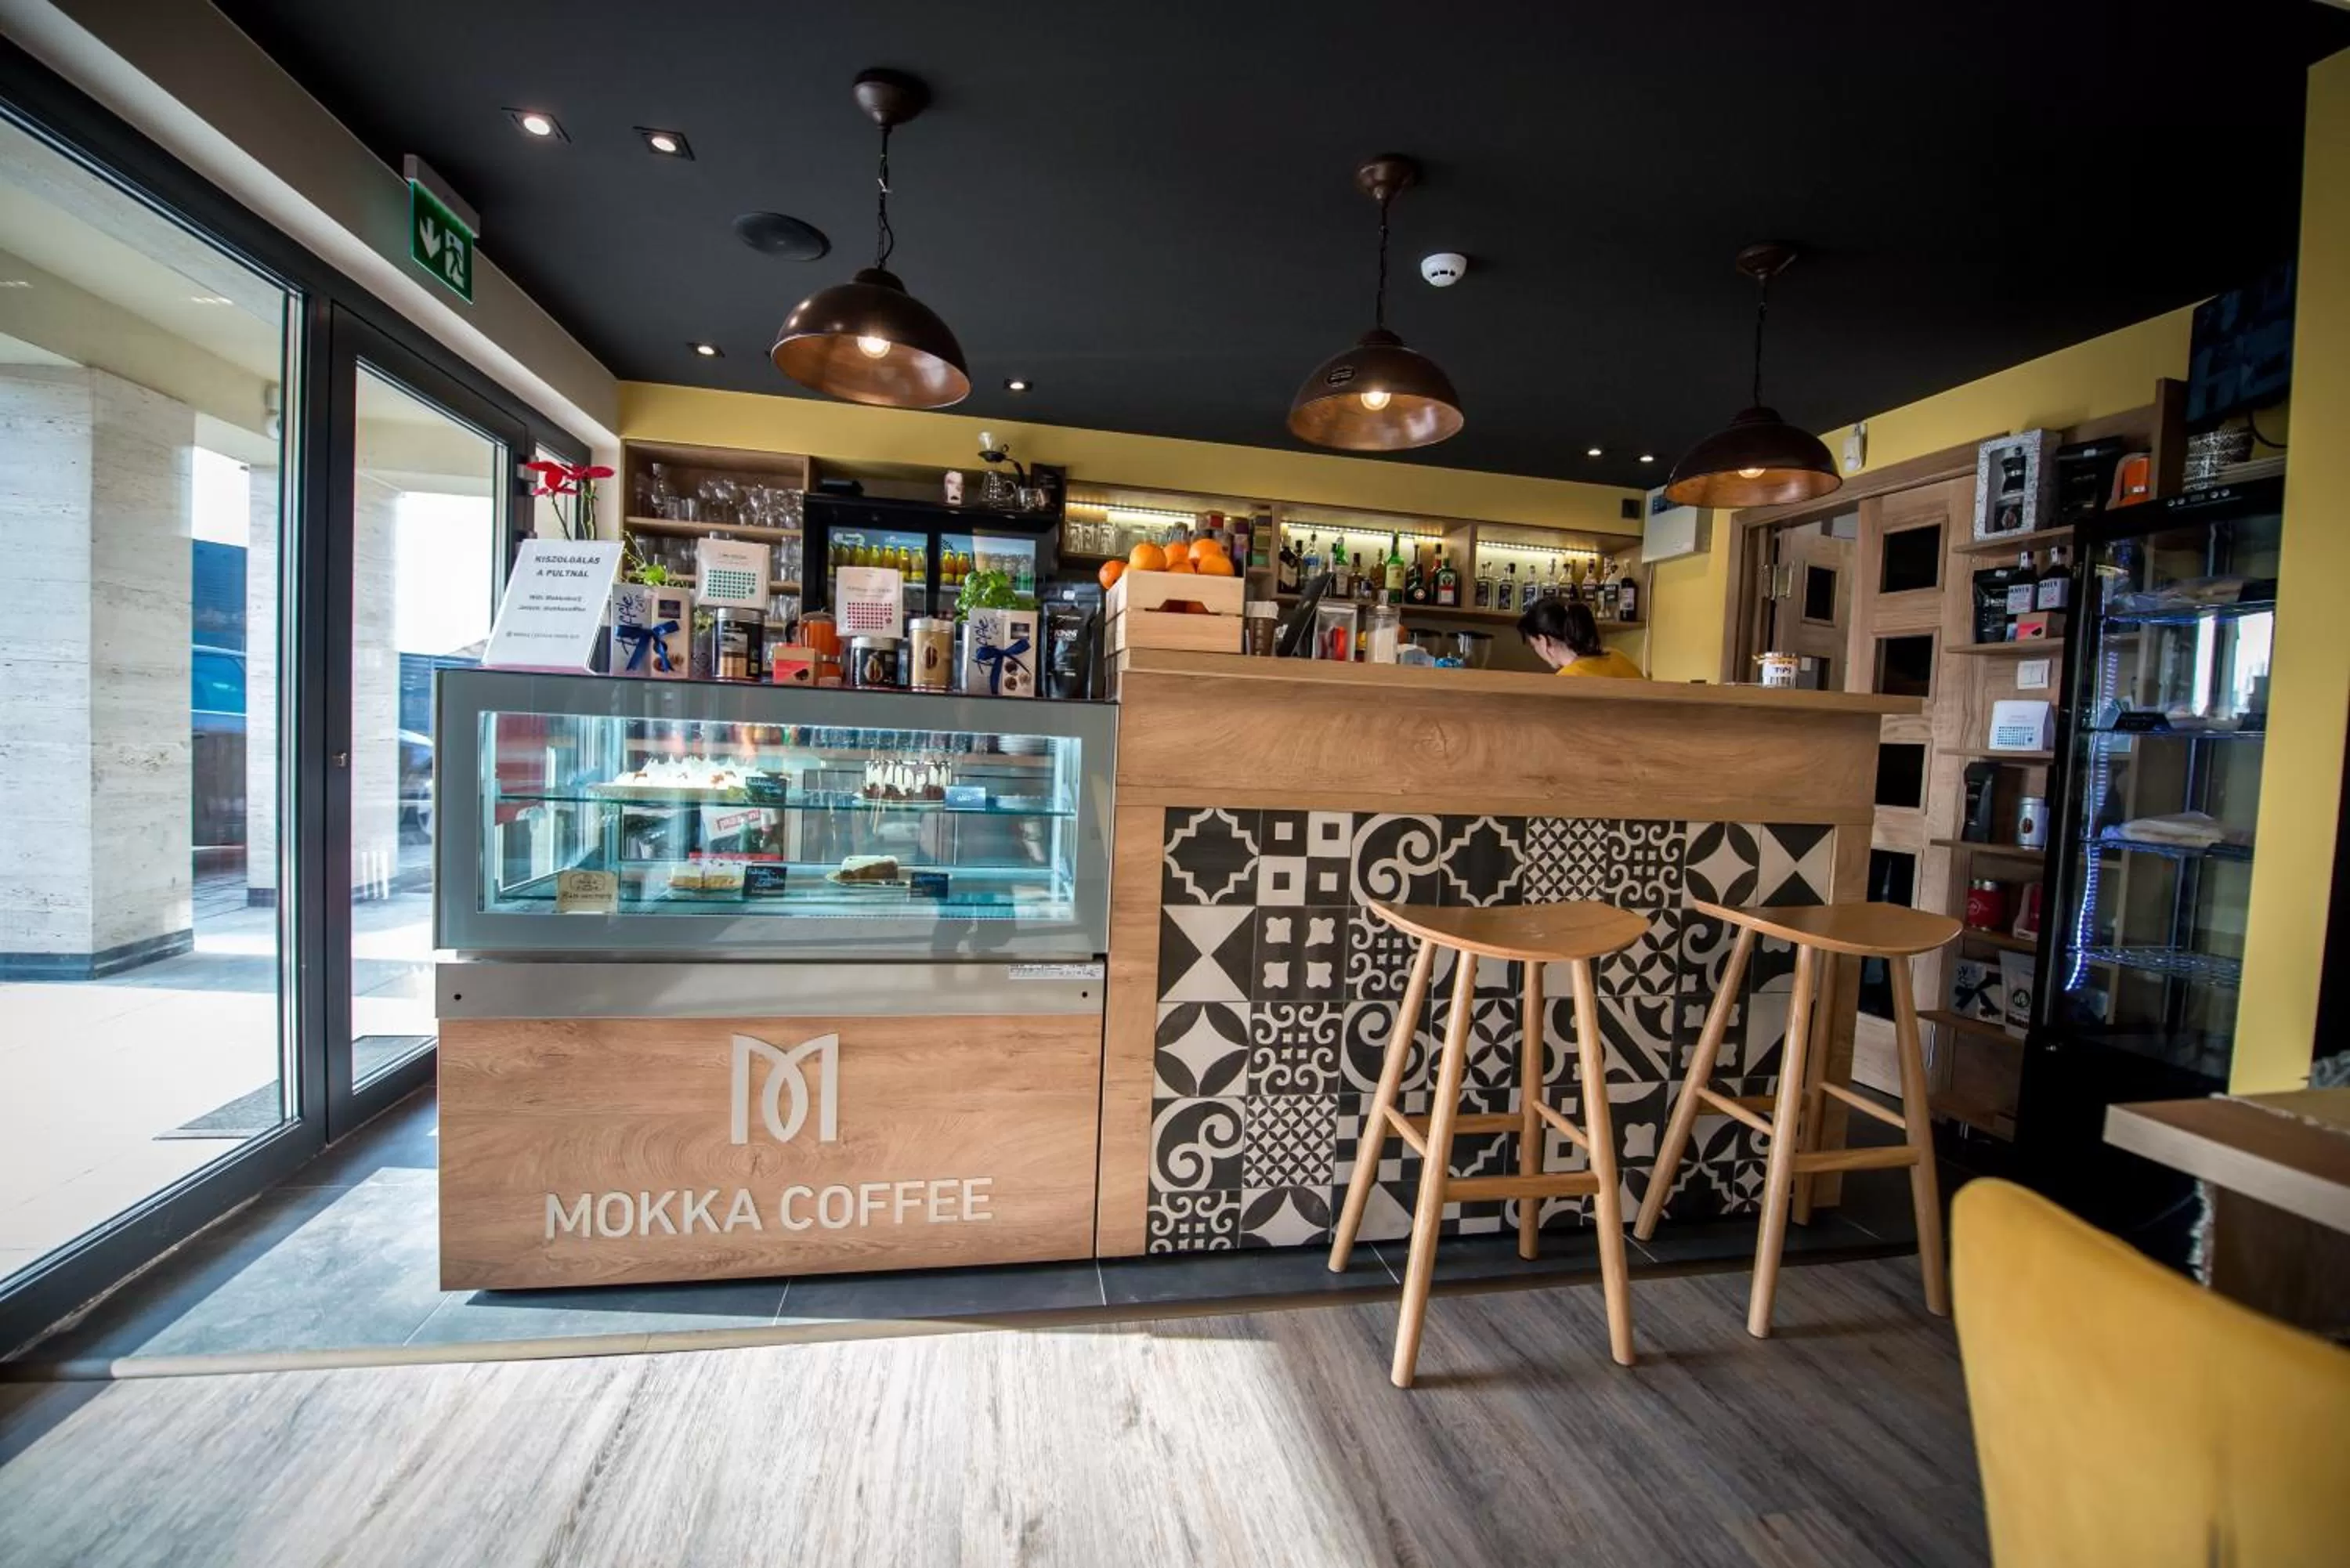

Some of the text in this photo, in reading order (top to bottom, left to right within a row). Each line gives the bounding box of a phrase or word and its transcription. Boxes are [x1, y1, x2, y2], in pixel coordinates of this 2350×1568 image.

[536, 569, 544, 577] A
[544, 1176, 993, 1239] MOKKA COFFEE
